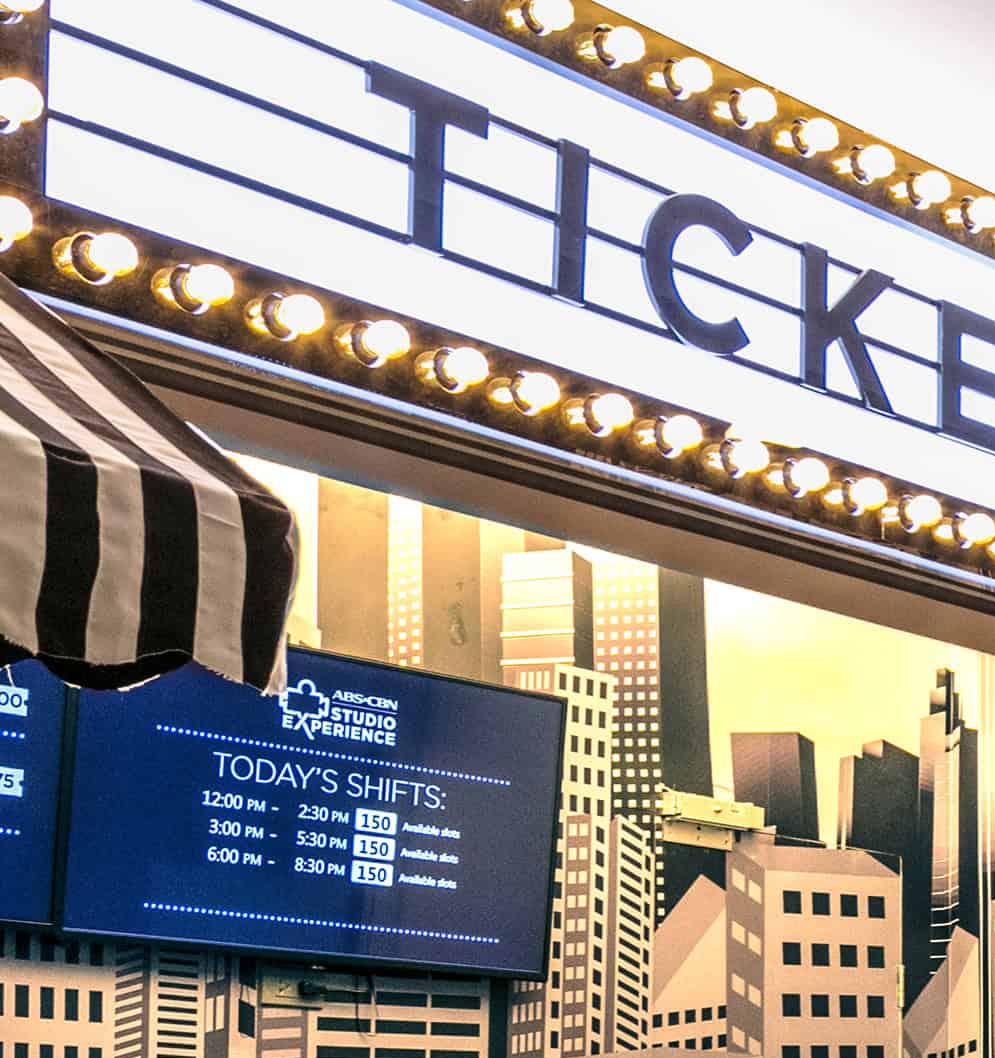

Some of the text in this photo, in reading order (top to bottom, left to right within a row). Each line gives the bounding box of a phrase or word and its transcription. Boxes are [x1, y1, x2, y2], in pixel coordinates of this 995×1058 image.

[282, 713, 397, 746] EXPERIENCE
[330, 707, 397, 730] STUDIO
[213, 751, 446, 810] TODAY'S SHIFTS:
[202, 790, 243, 809] 12:00
[247, 798, 266, 812] PM
[298, 804, 329, 821] 2:30
[331, 810, 349, 824] PM
[361, 814, 391, 831] 150
[209, 818, 241, 837] 3:00
[245, 825, 264, 839] PM
[296, 831, 327, 848] 5:30
[329, 837, 347, 850] PM
[359, 839, 389, 857] 150
[207, 846, 239, 864] 6:00
[243, 852, 262, 866] PM
[294, 857, 325, 874] 8:30
[327, 862, 345, 876] PM
[357, 865, 387, 882] 150
